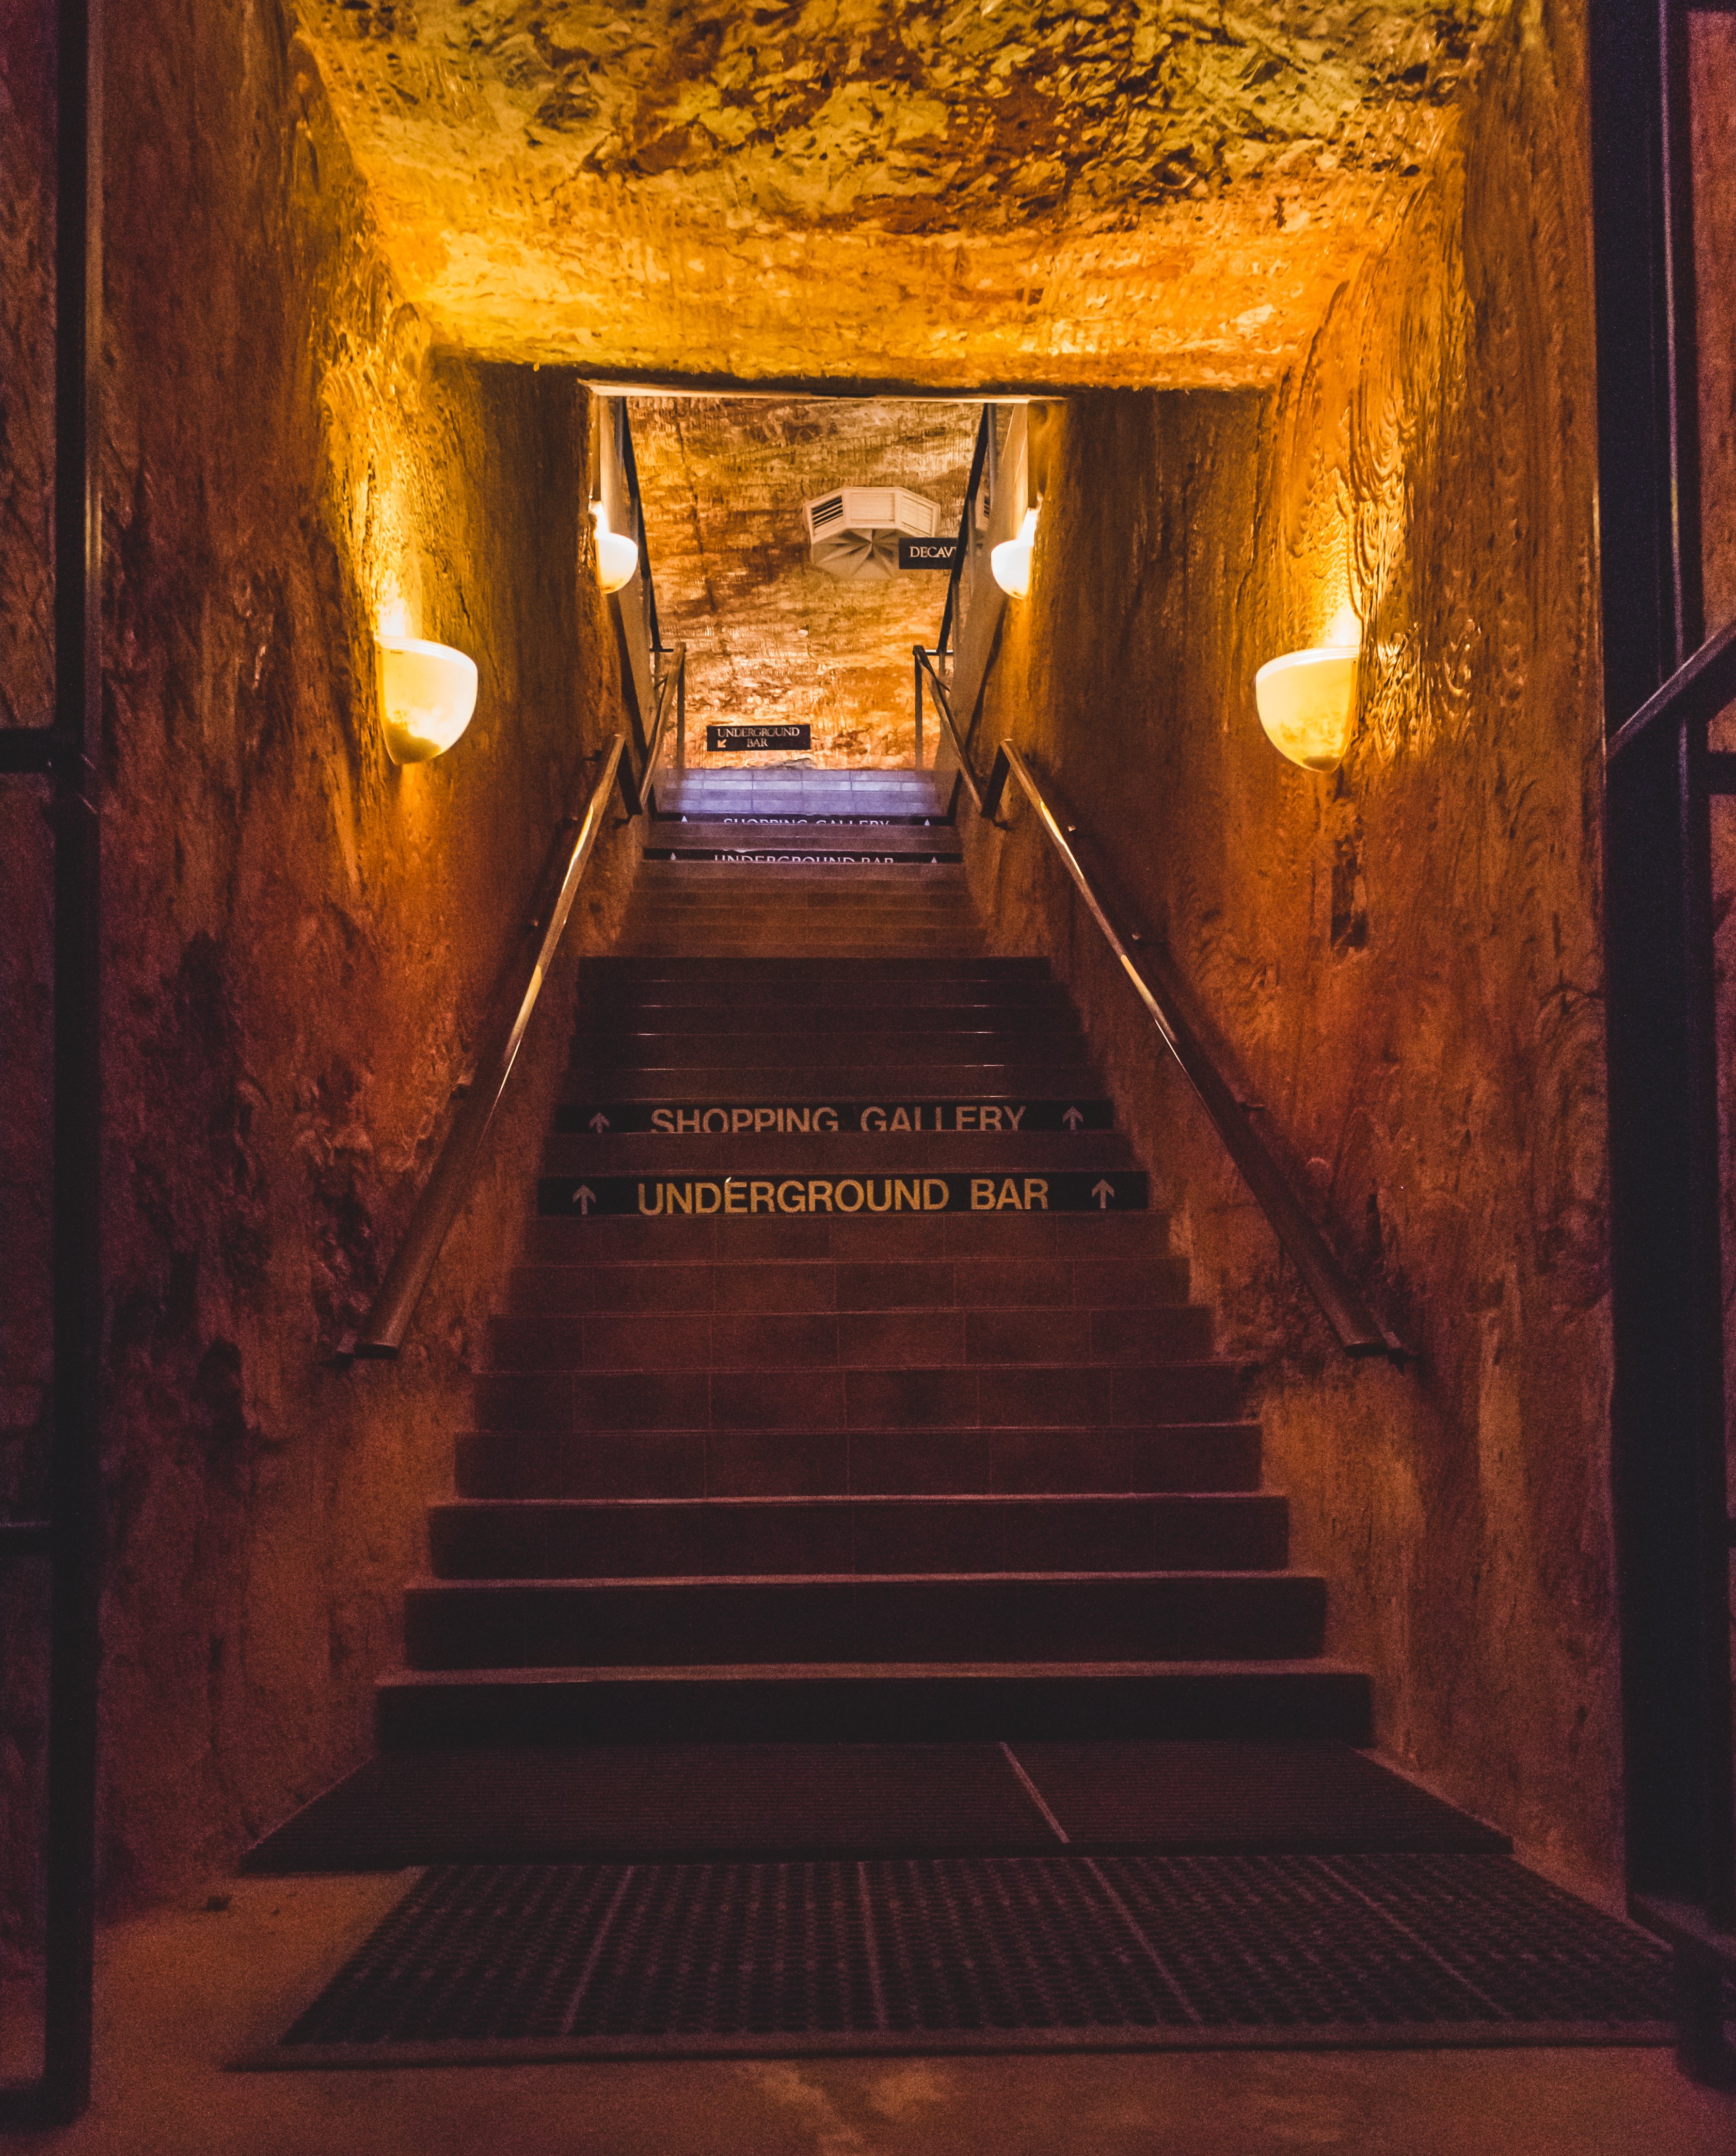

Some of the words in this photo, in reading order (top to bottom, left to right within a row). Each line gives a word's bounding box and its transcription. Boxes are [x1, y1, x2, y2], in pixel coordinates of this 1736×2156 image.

[909, 546, 957, 558] DECAV
[716, 727, 800, 737] UNDERGROUND
[746, 738, 768, 747] BAR
[650, 1106, 839, 1132] SHOPPING
[860, 1106, 1027, 1132] GALLERY
[637, 1178, 950, 1215] UNDERGROUND
[970, 1178, 1049, 1210] BAR
